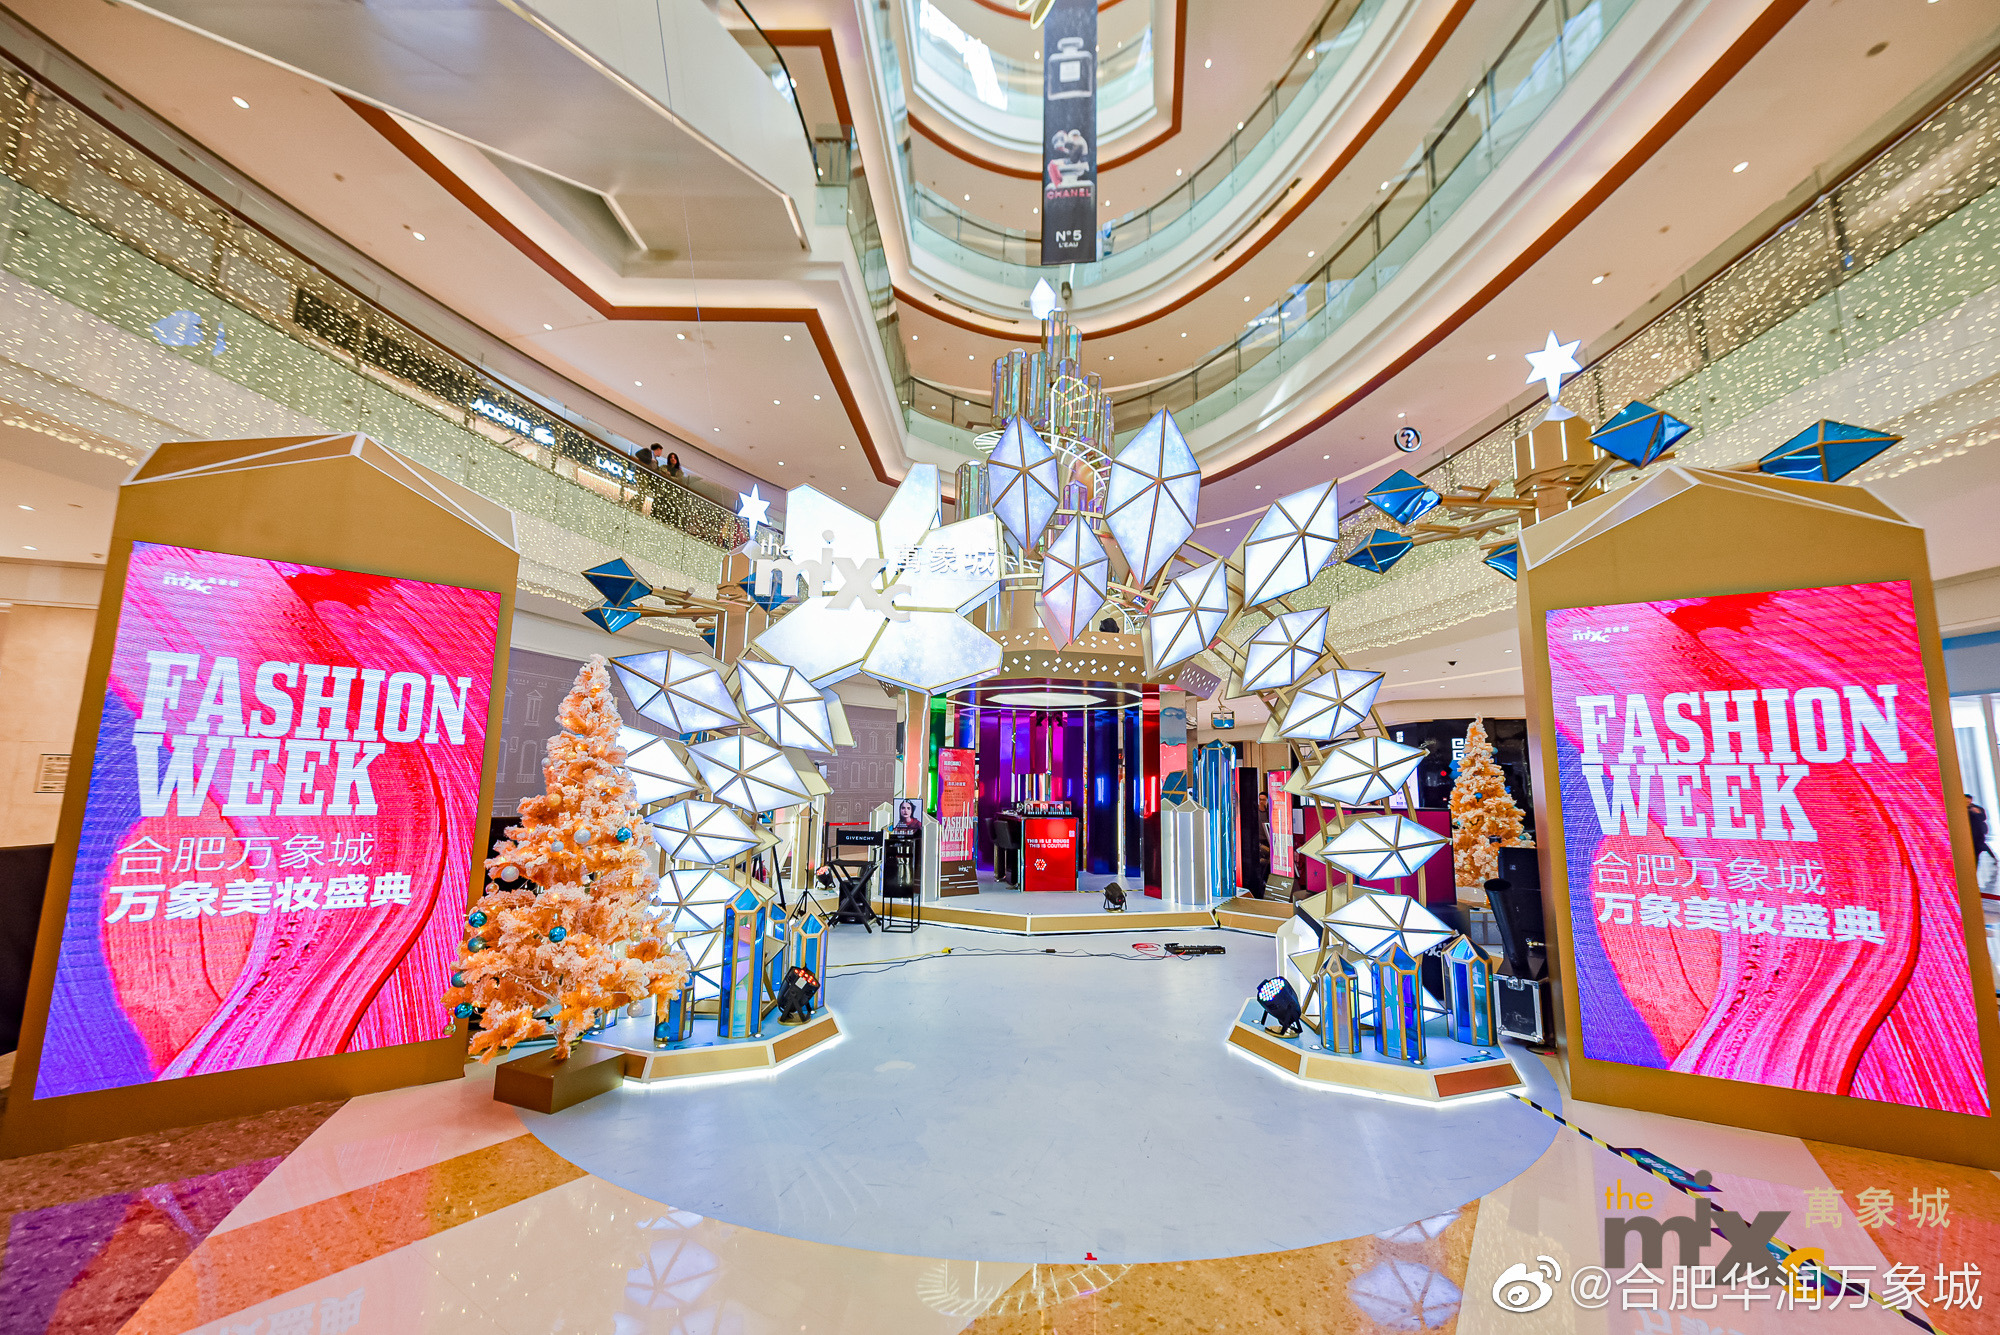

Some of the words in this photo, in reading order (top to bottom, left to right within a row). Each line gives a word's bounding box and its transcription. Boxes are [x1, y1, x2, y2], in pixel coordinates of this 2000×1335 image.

[1046, 187, 1091, 200] CHANEL
[468, 398, 531, 435] ACOSTE
[761, 533, 794, 557] the
[133, 650, 473, 745] FASHION
[1576, 684, 1908, 765] FASHION
[132, 732, 386, 817] WEEK
[941, 816, 974, 829] FASHION
[1582, 764, 1818, 843] WEEK
[115, 832, 375, 876] 合肥万象城
[941, 828, 965, 842] WEEK
[1592, 850, 1827, 896] 合肥万象城
[104, 871, 413, 924] 万象美妆盛典
[1594, 891, 1887, 946] 万象美妆盛典
